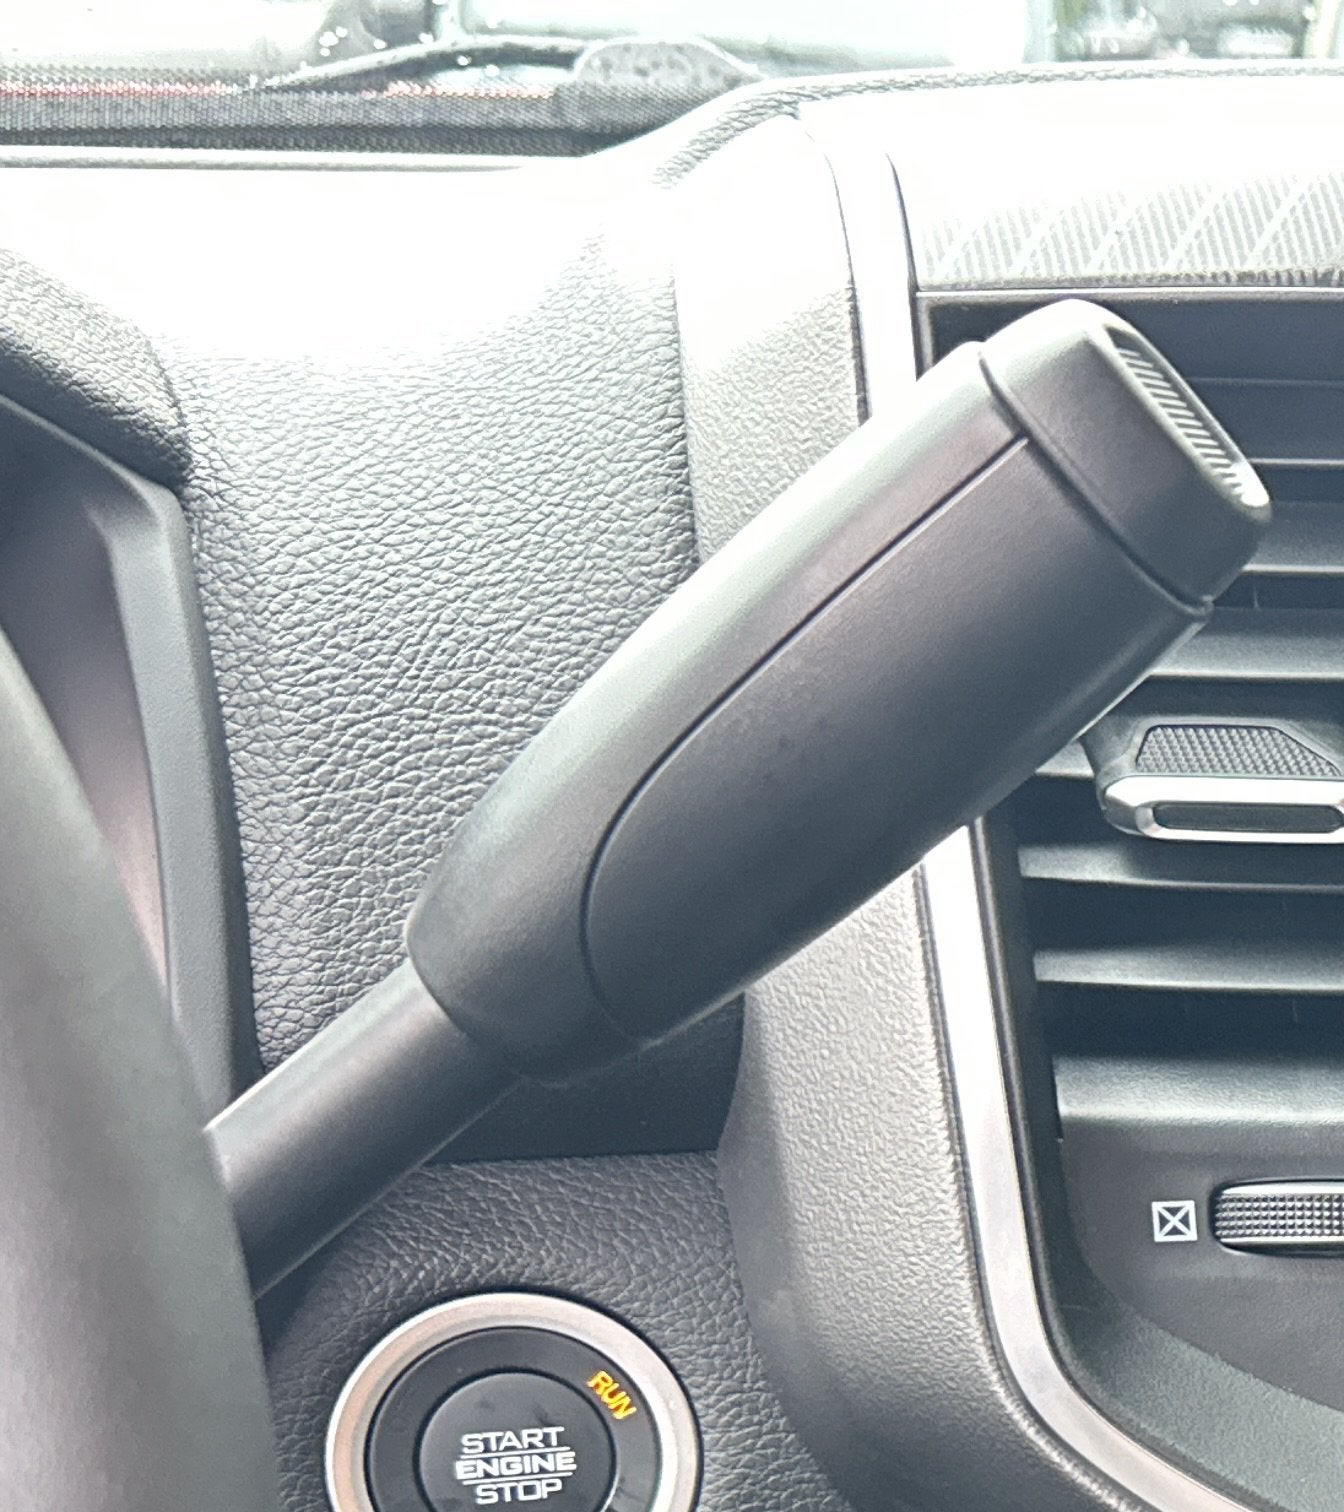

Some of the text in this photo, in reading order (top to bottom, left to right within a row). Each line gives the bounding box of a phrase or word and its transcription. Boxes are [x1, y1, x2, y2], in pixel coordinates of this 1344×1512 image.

[587, 1370, 637, 1420] RUN
[461, 1426, 564, 1453] START
[456, 1451, 577, 1479] ENGINE
[475, 1478, 563, 1504] STOP
